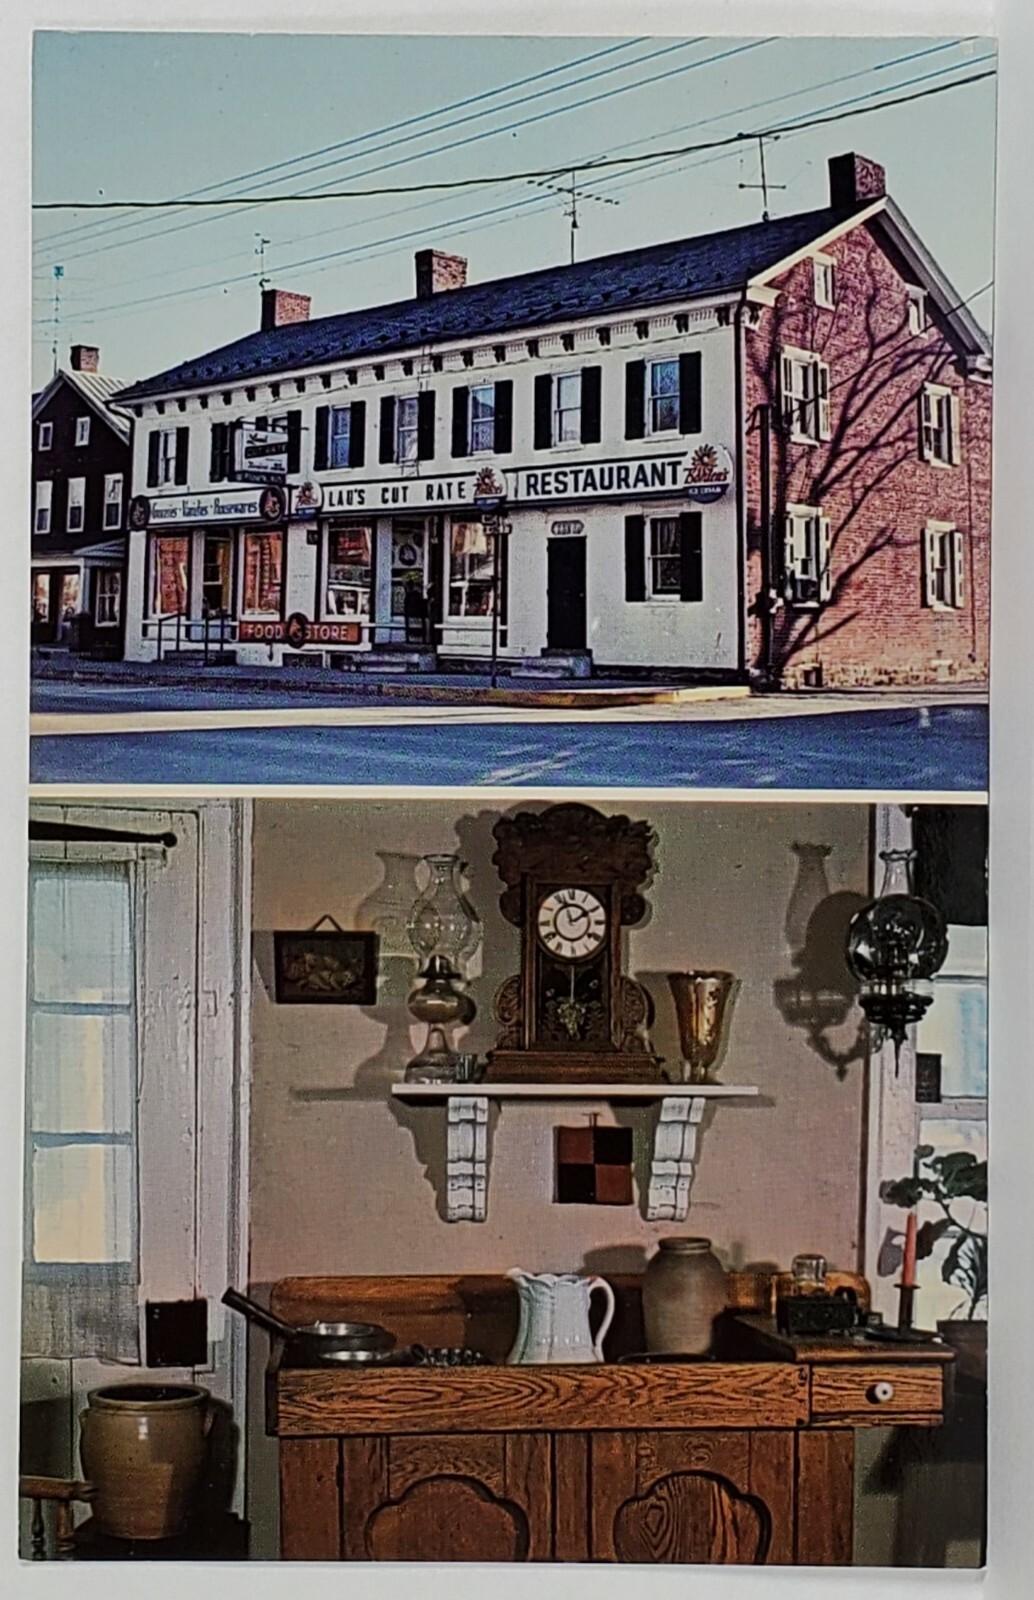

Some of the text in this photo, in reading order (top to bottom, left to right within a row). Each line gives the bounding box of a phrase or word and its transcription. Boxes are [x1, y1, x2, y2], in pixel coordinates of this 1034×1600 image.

[526, 461, 682, 496] RESTAURANT
[329, 488, 366, 507] LAU'S
[381, 486, 409, 503] CUT
[426, 481, 466, 501] RATE
[247, 624, 348, 641] FOOD STORE
